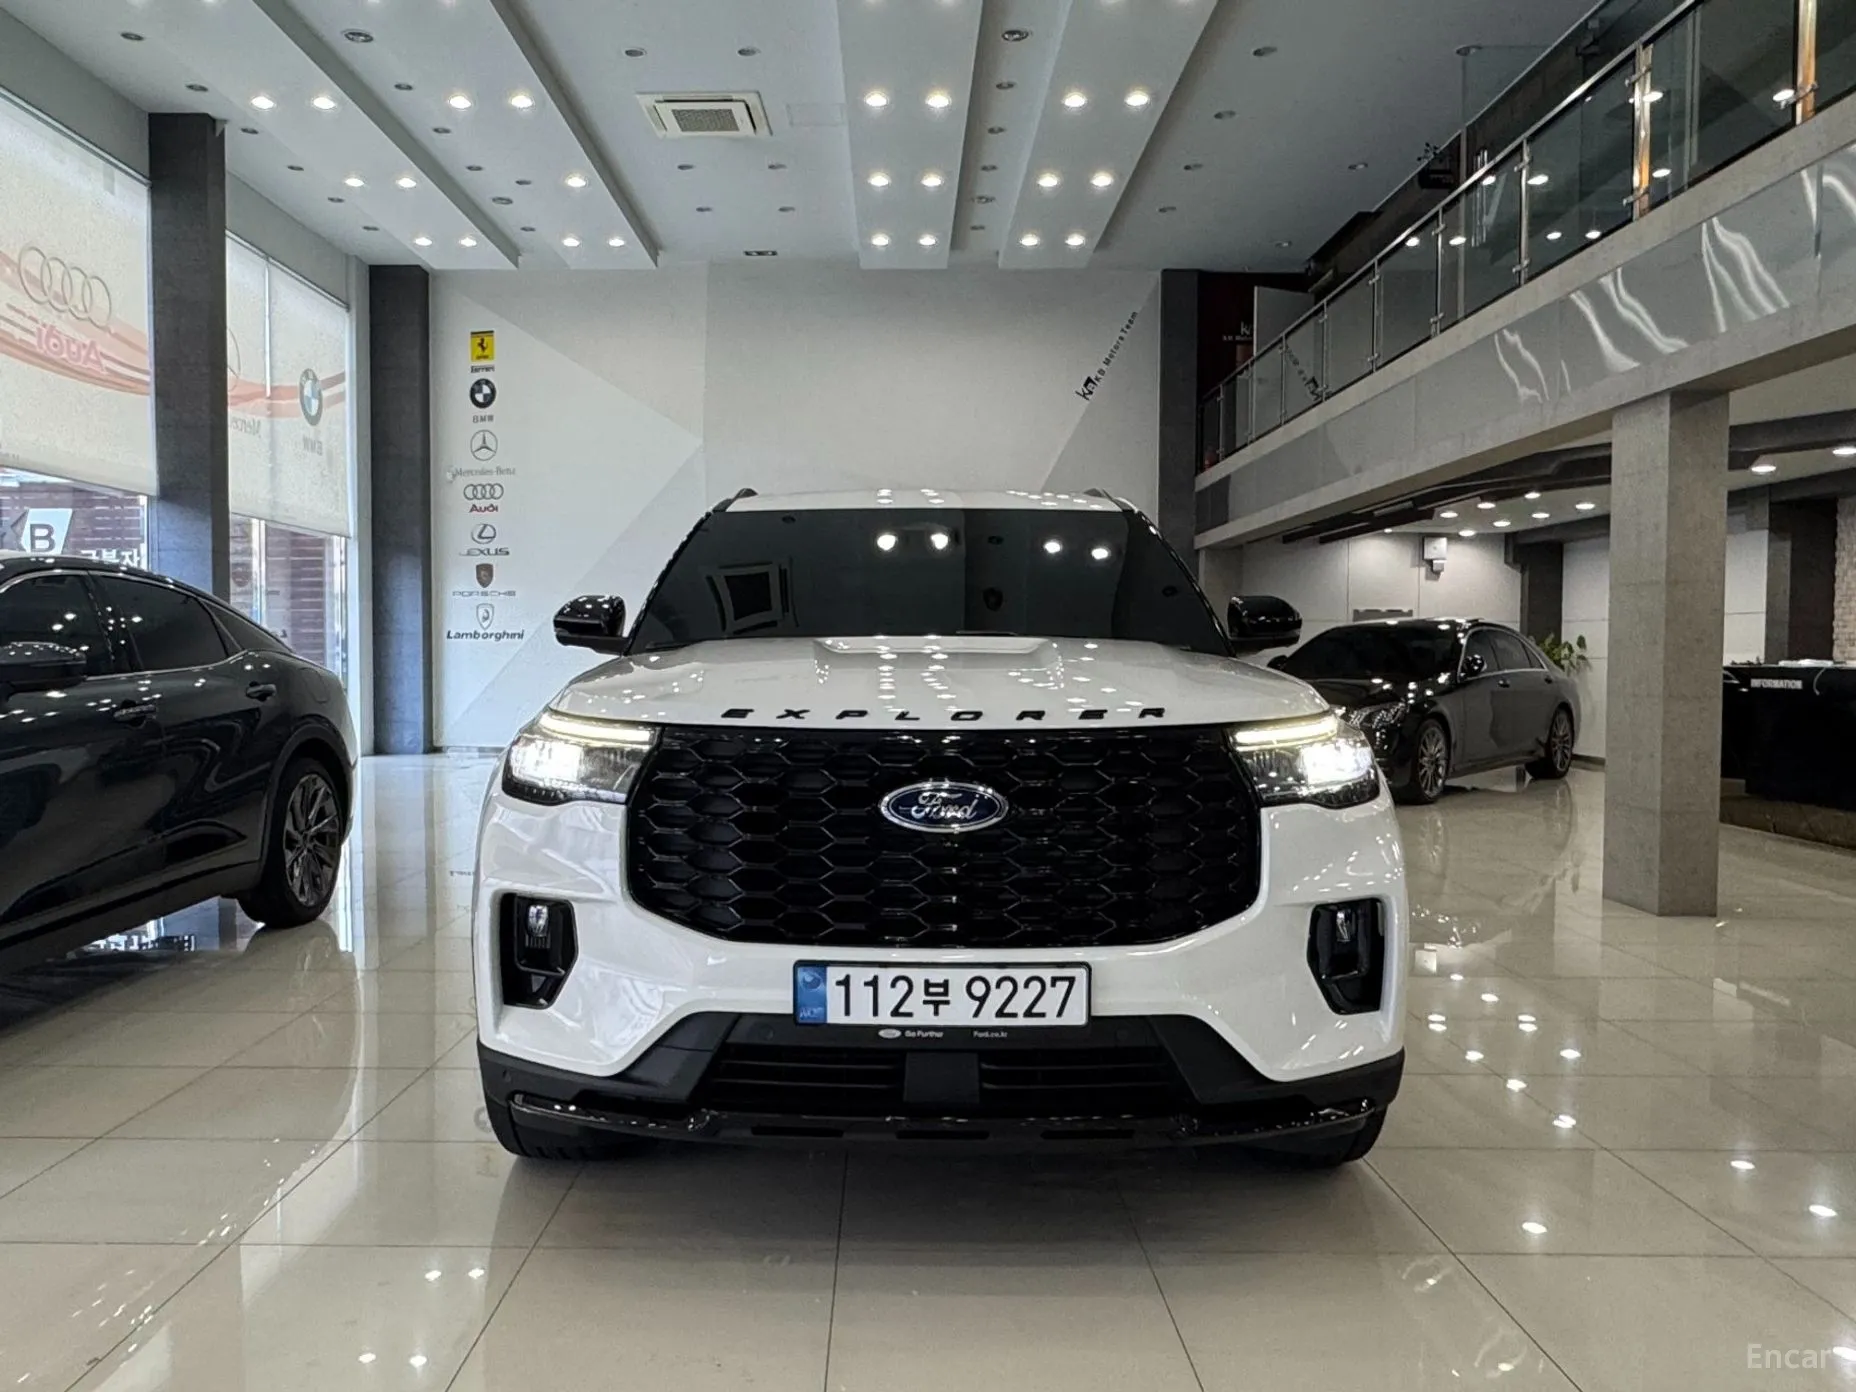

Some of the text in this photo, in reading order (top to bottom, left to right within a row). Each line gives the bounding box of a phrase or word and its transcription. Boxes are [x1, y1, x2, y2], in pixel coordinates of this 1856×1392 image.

[469, 503, 499, 513] Audi
[459, 548, 510, 557] LEXUS
[446, 629, 525, 642] Lamborghini
[1750, 678, 1803, 690] INFORMATION
[721, 707, 1166, 721] EXPLORER
[898, 791, 978, 820] Ford
[835, 973, 1077, 1019] 112부 9227
